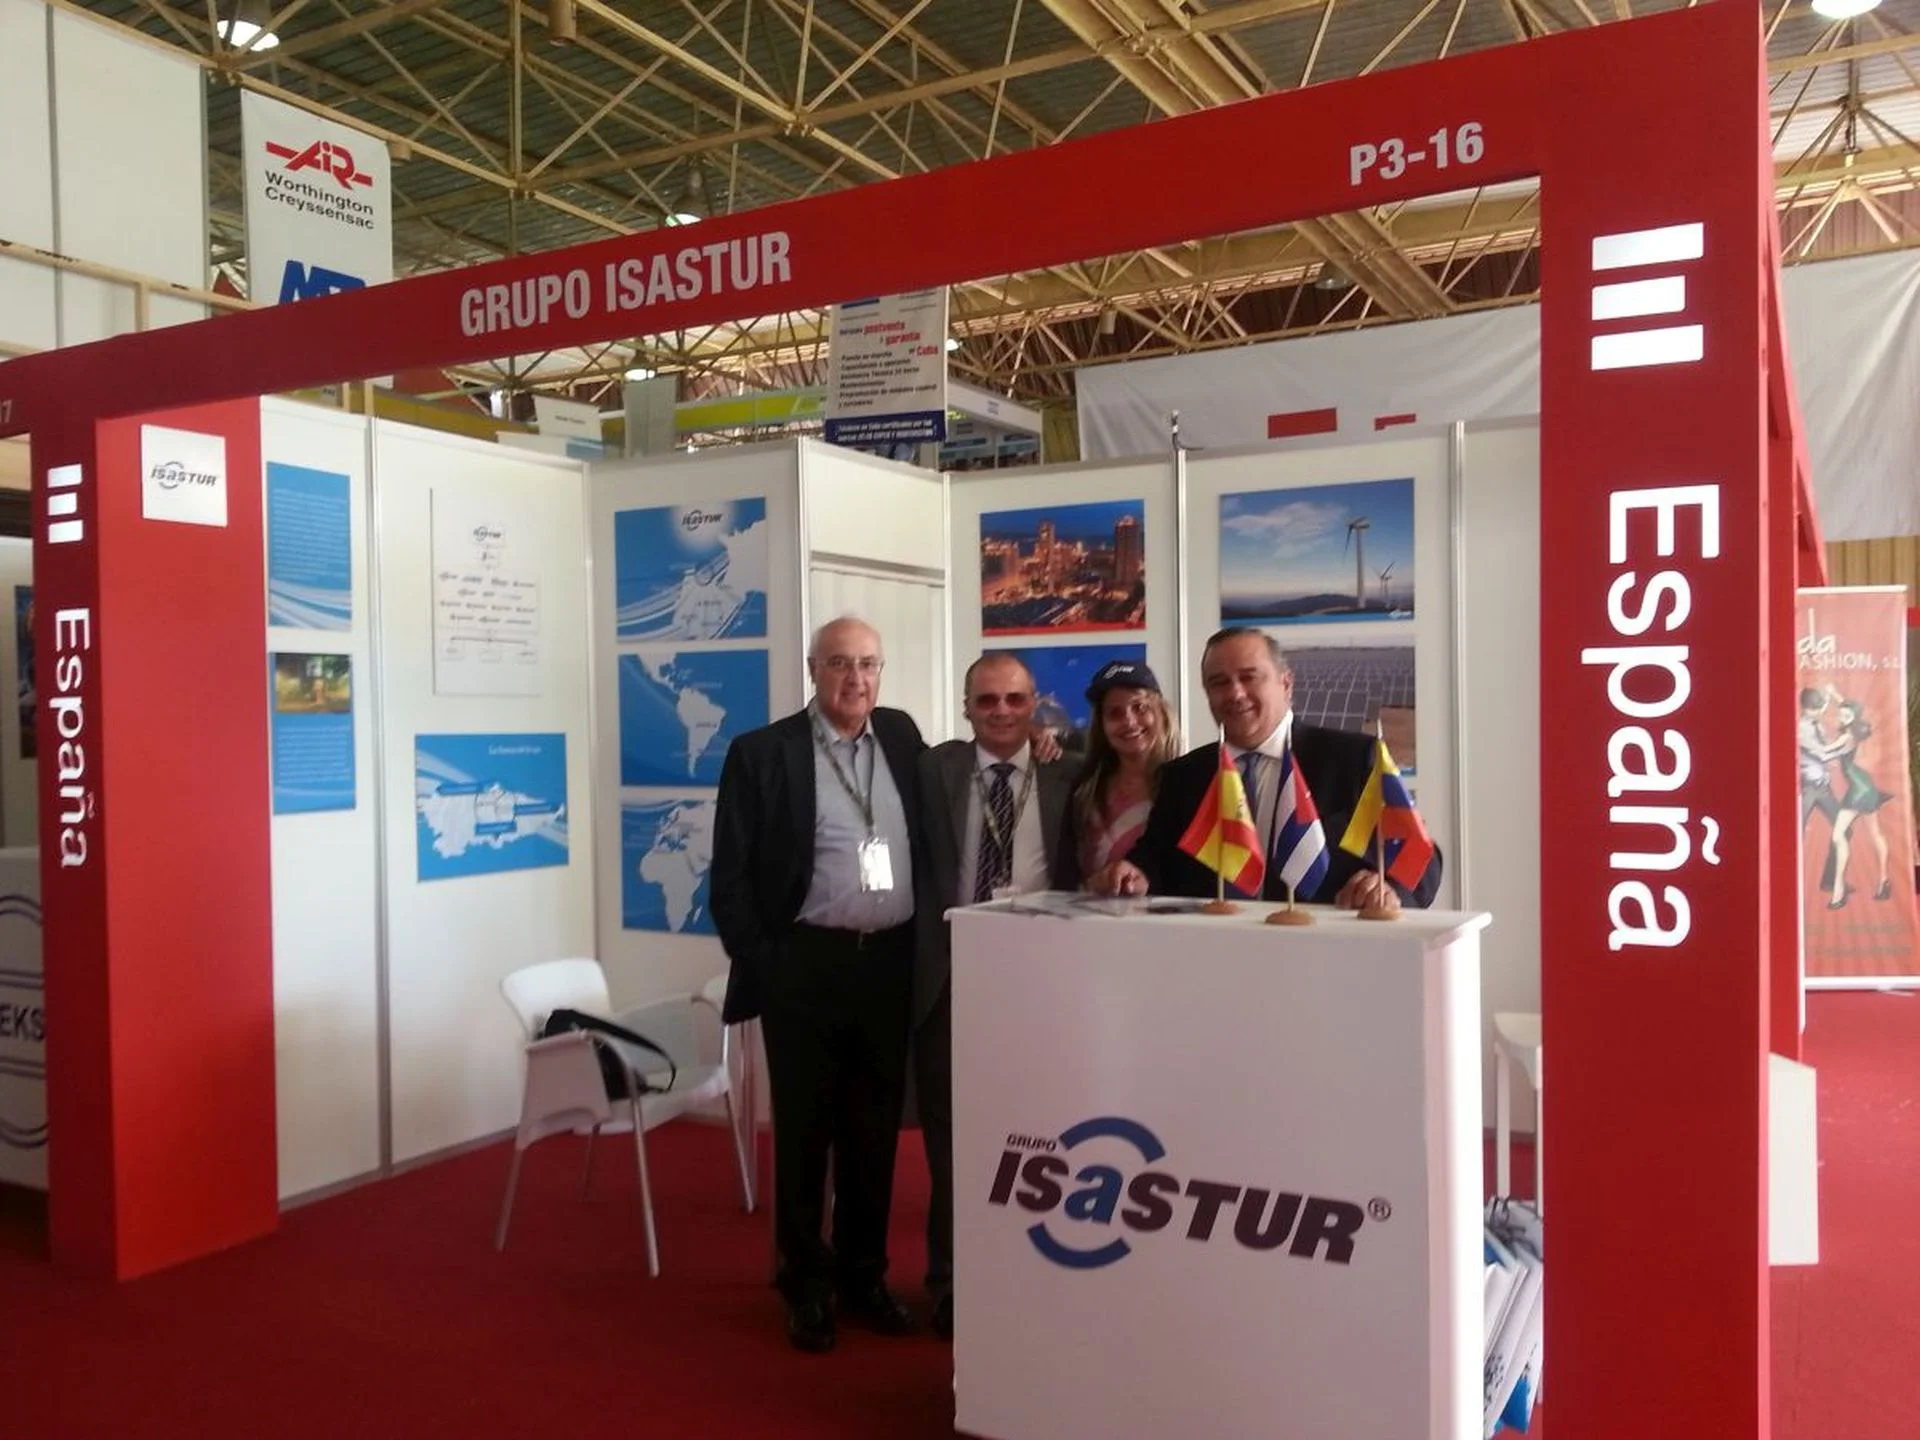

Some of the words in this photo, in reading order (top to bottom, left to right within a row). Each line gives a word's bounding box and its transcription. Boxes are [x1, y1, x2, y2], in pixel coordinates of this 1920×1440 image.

[1350, 122, 1484, 185] P3-16
[265, 170, 374, 215] Worthington
[265, 186, 375, 230] Creyssensac
[460, 268, 590, 337] GRUPO
[605, 231, 792, 313] ISASTUR
[49, 608, 95, 868] España
[1581, 484, 1721, 952] España
[1006, 1133, 1057, 1152] GRUPO
